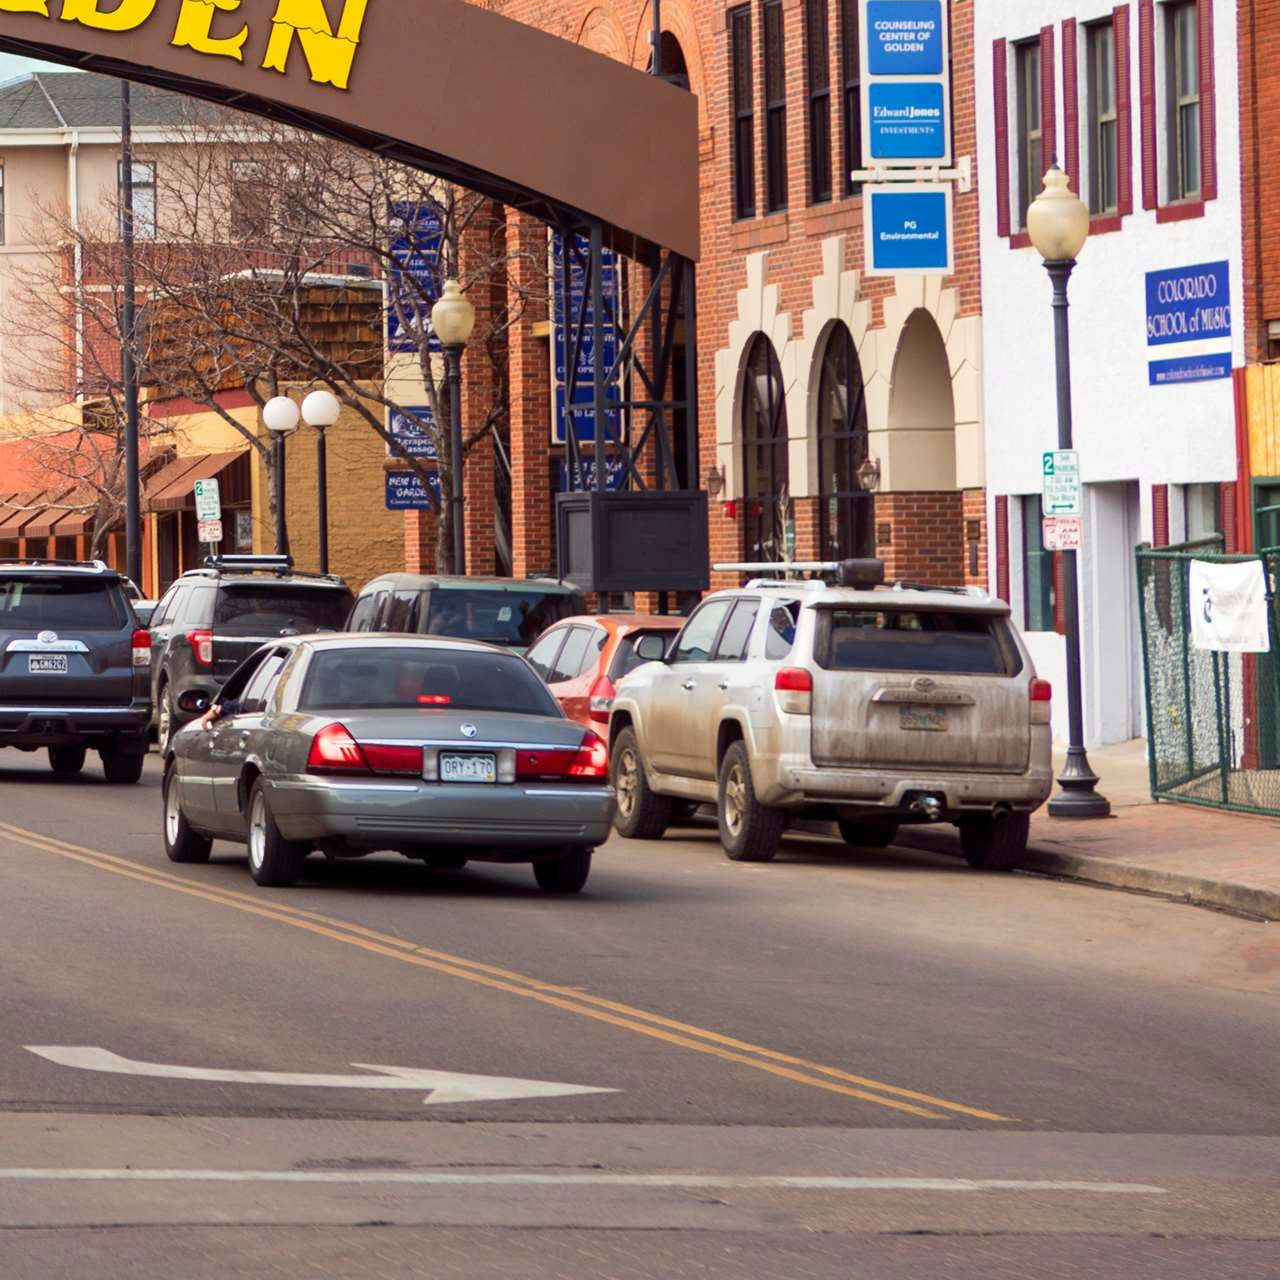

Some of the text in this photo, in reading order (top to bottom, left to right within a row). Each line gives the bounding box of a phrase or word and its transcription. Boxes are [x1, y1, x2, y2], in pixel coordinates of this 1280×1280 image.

[874, 21, 935, 30] COUNSELING
[879, 31, 931, 41] CENTER OF
[883, 43, 924, 52] GOLDEN
[904, 221, 917, 230] PG
[880, 231, 939, 240] Environmental
[1158, 274, 1217, 303] COLORADO
[1146, 305, 1231, 338] SCHOOL of MUSIC
[1044, 456, 1053, 472] 2
[388, 477, 410, 486] NEW
[196, 482, 203, 495] 2
[396, 488, 428, 497] GARDE
